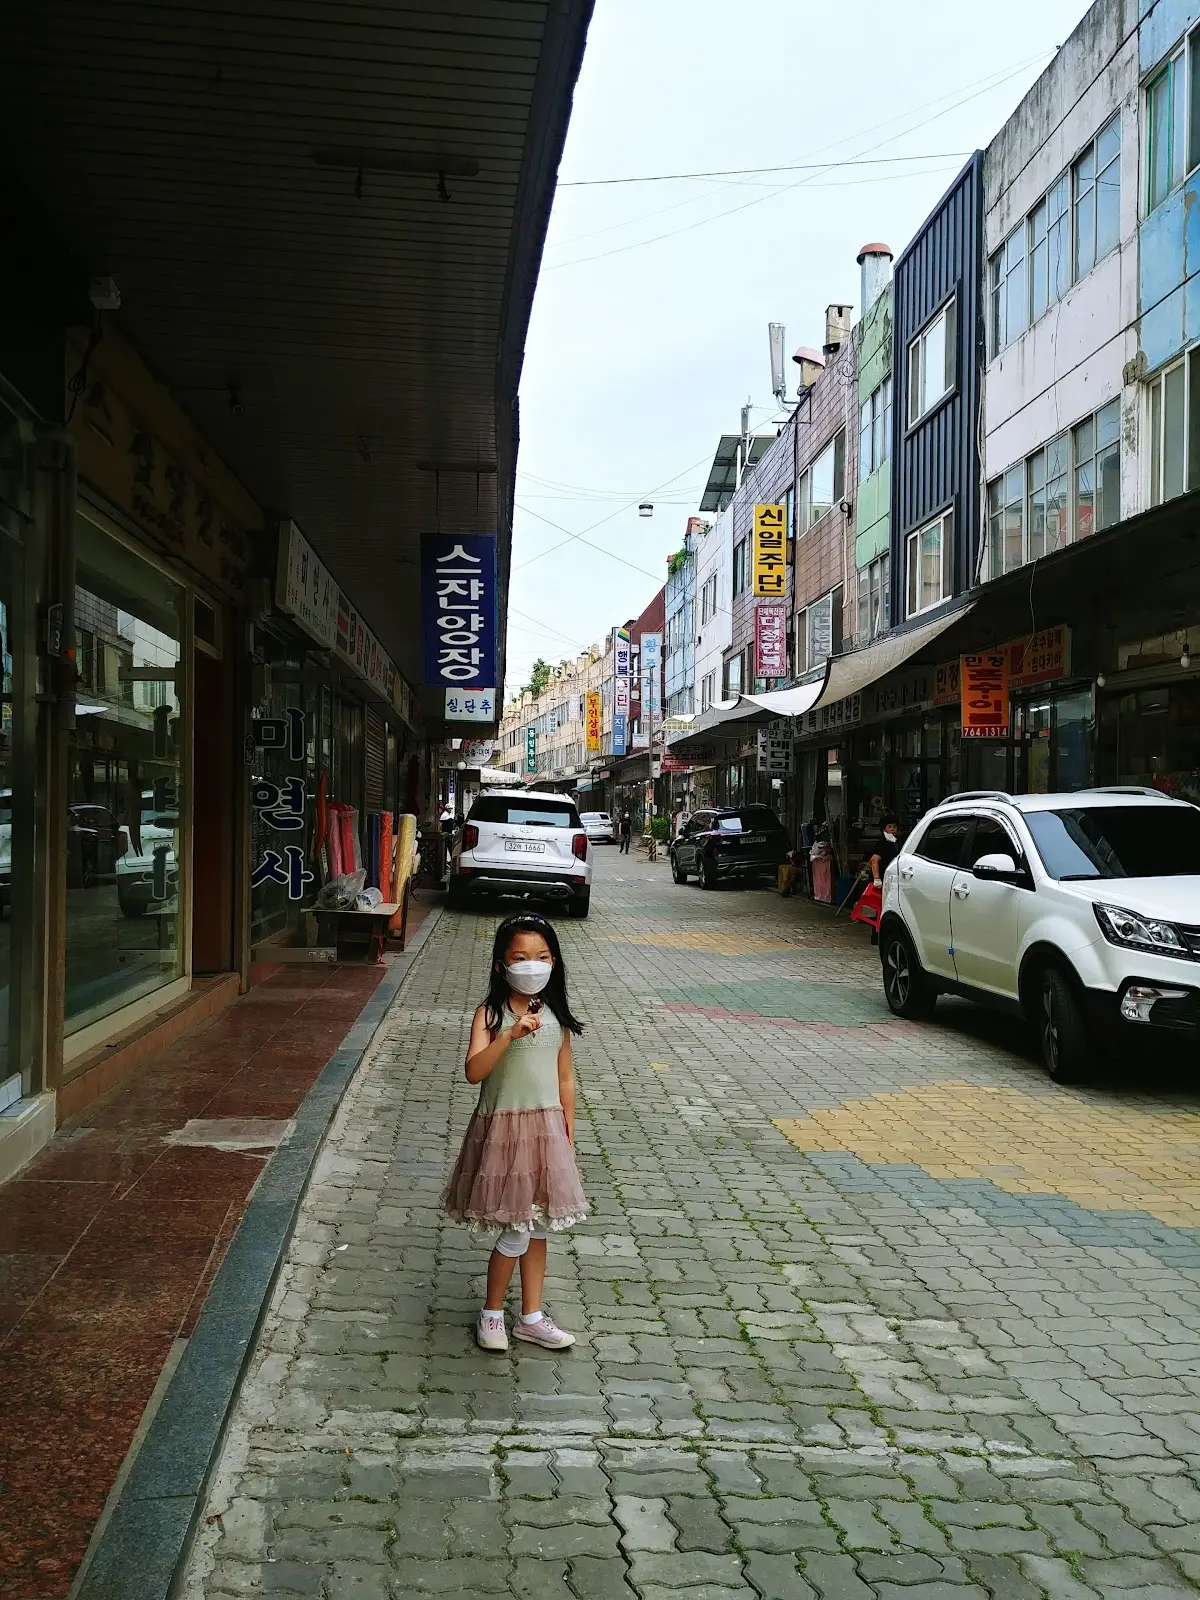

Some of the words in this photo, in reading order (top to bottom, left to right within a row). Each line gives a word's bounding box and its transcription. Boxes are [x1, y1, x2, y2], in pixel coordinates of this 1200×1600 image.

[758, 509, 784, 592] 신일주단
[435, 544, 485, 681] 스쟌양장
[964, 656, 1004, 667] 민정
[588, 699, 599, 739] 부인상회
[963, 727, 1008, 737] 764.1314
[252, 706, 315, 900] 미연사
